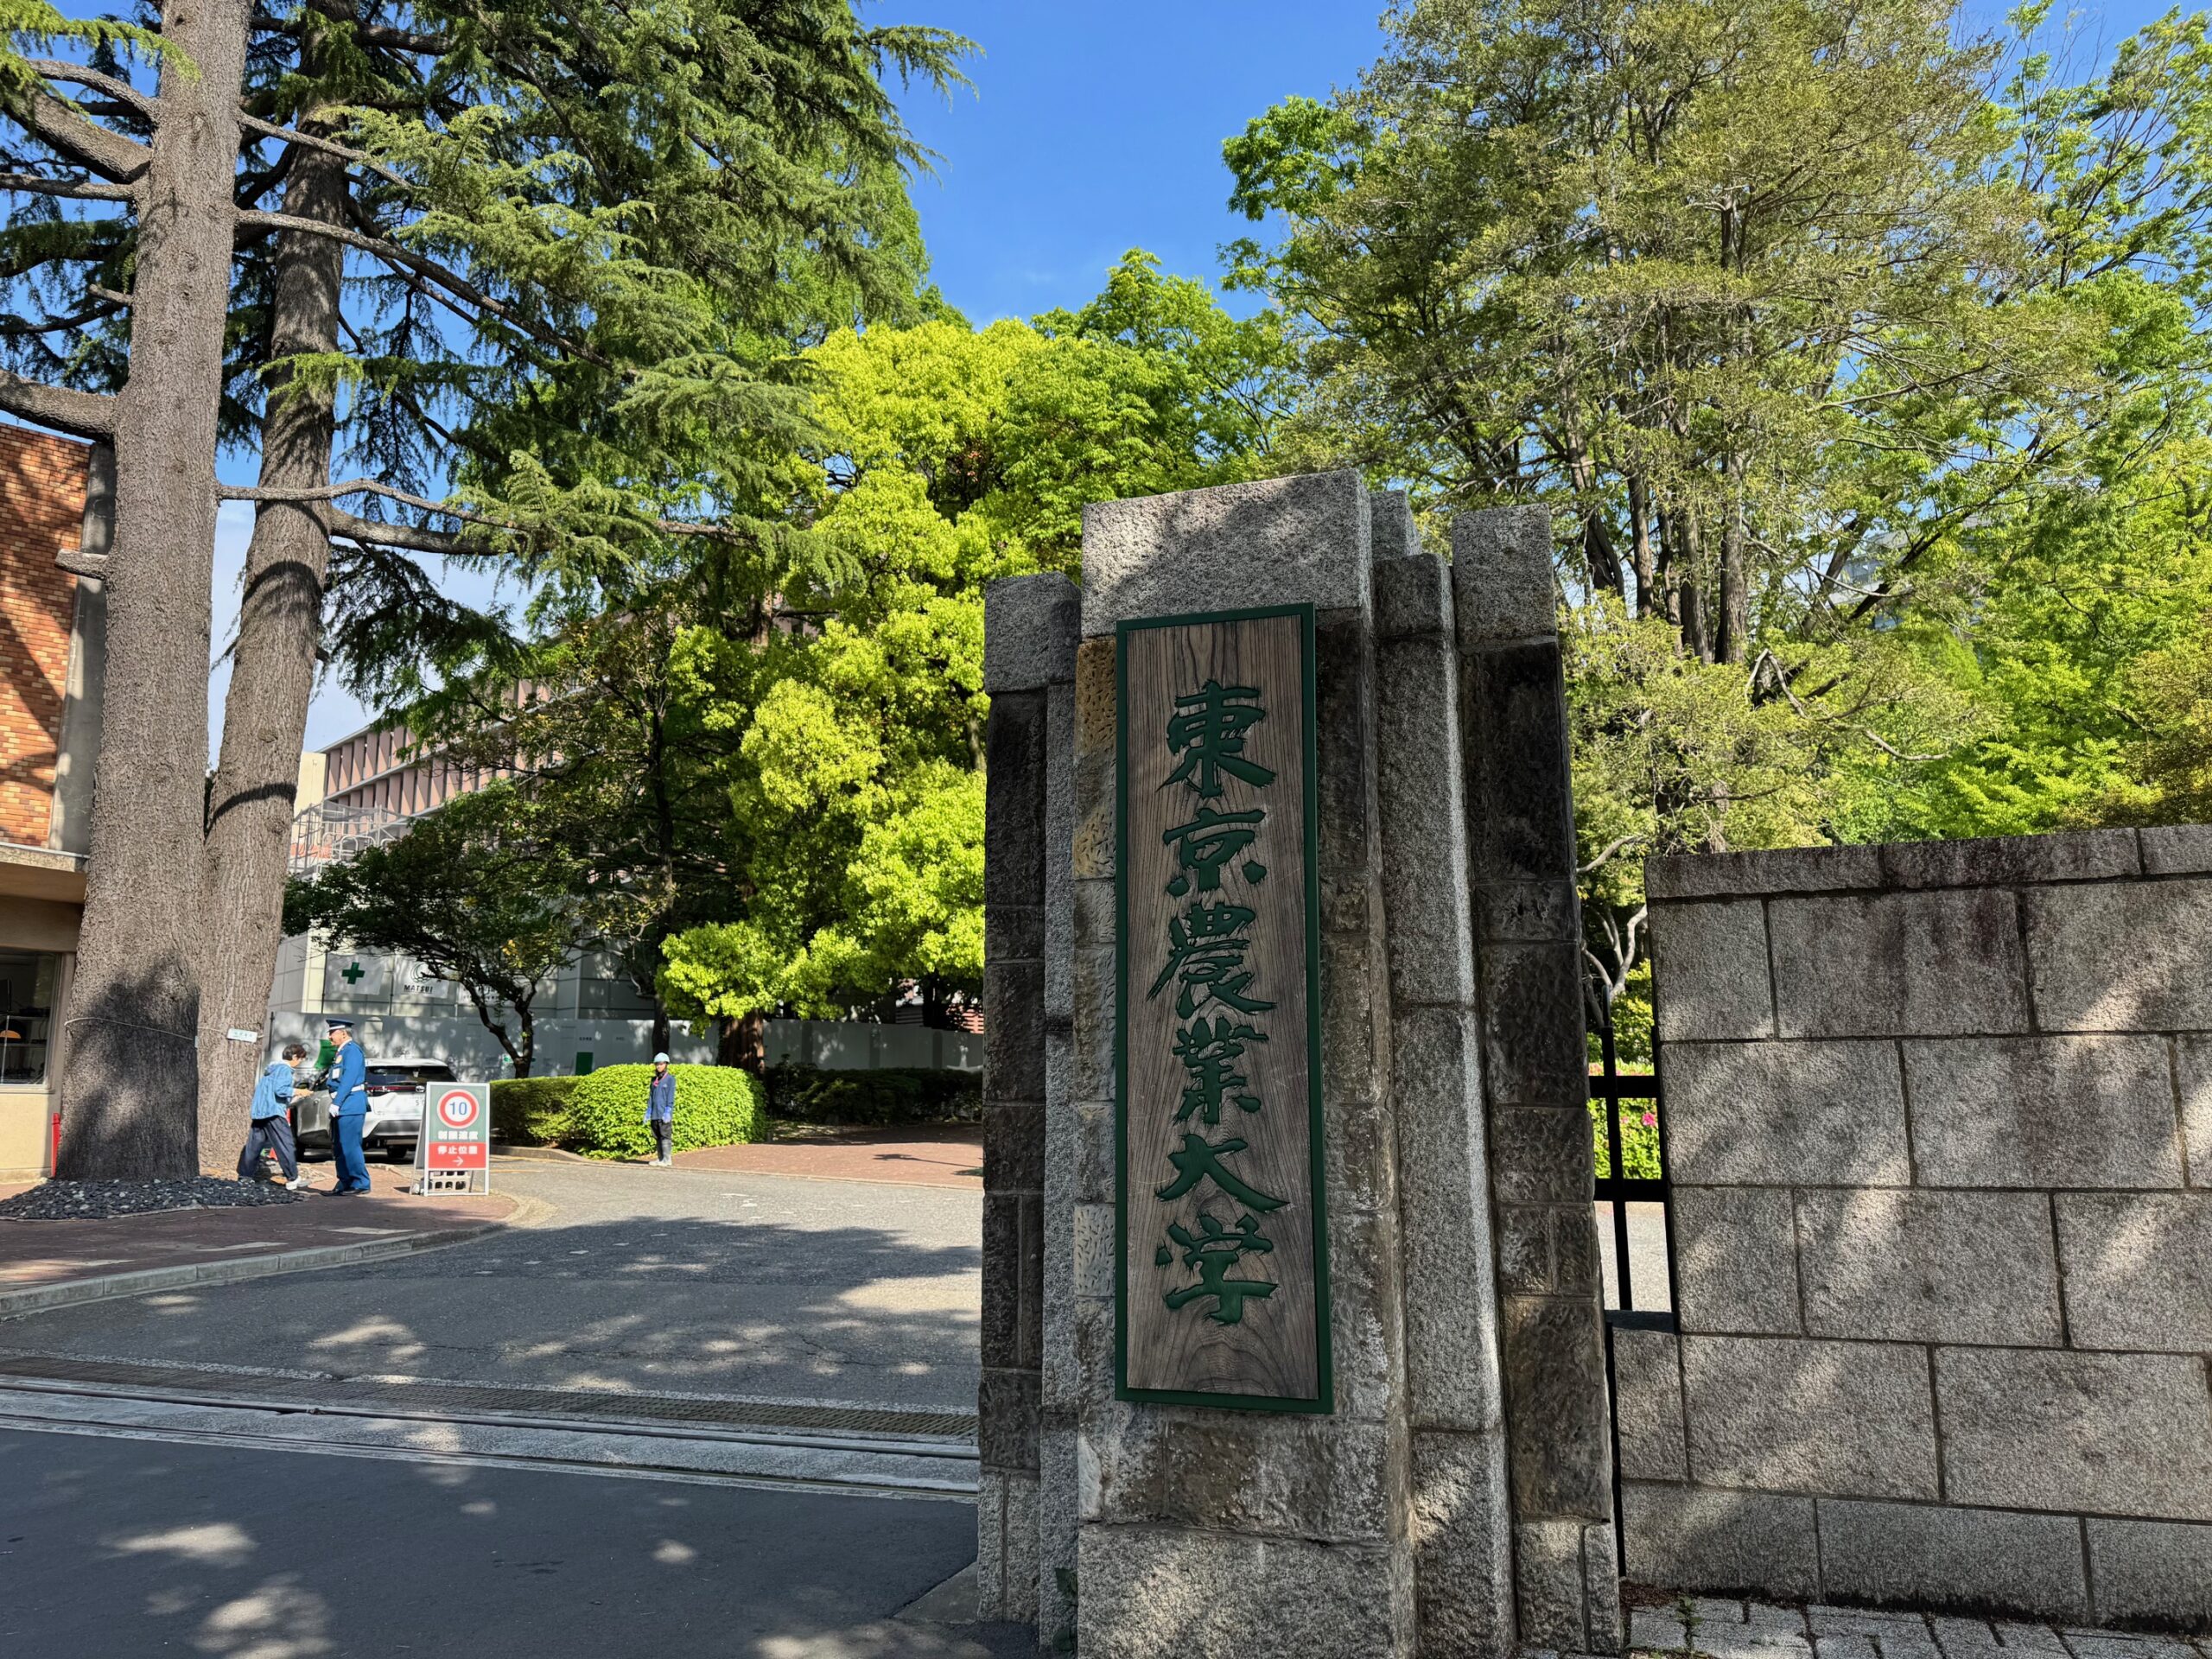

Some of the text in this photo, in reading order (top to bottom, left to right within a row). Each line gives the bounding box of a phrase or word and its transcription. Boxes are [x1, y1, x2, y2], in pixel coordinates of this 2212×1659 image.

[404, 984, 433, 993] MATSUI
[1147, 679, 1290, 1326] 東京農業大学
[449, 1102, 467, 1116] 10
[437, 1145, 478, 1155] 停止位置
